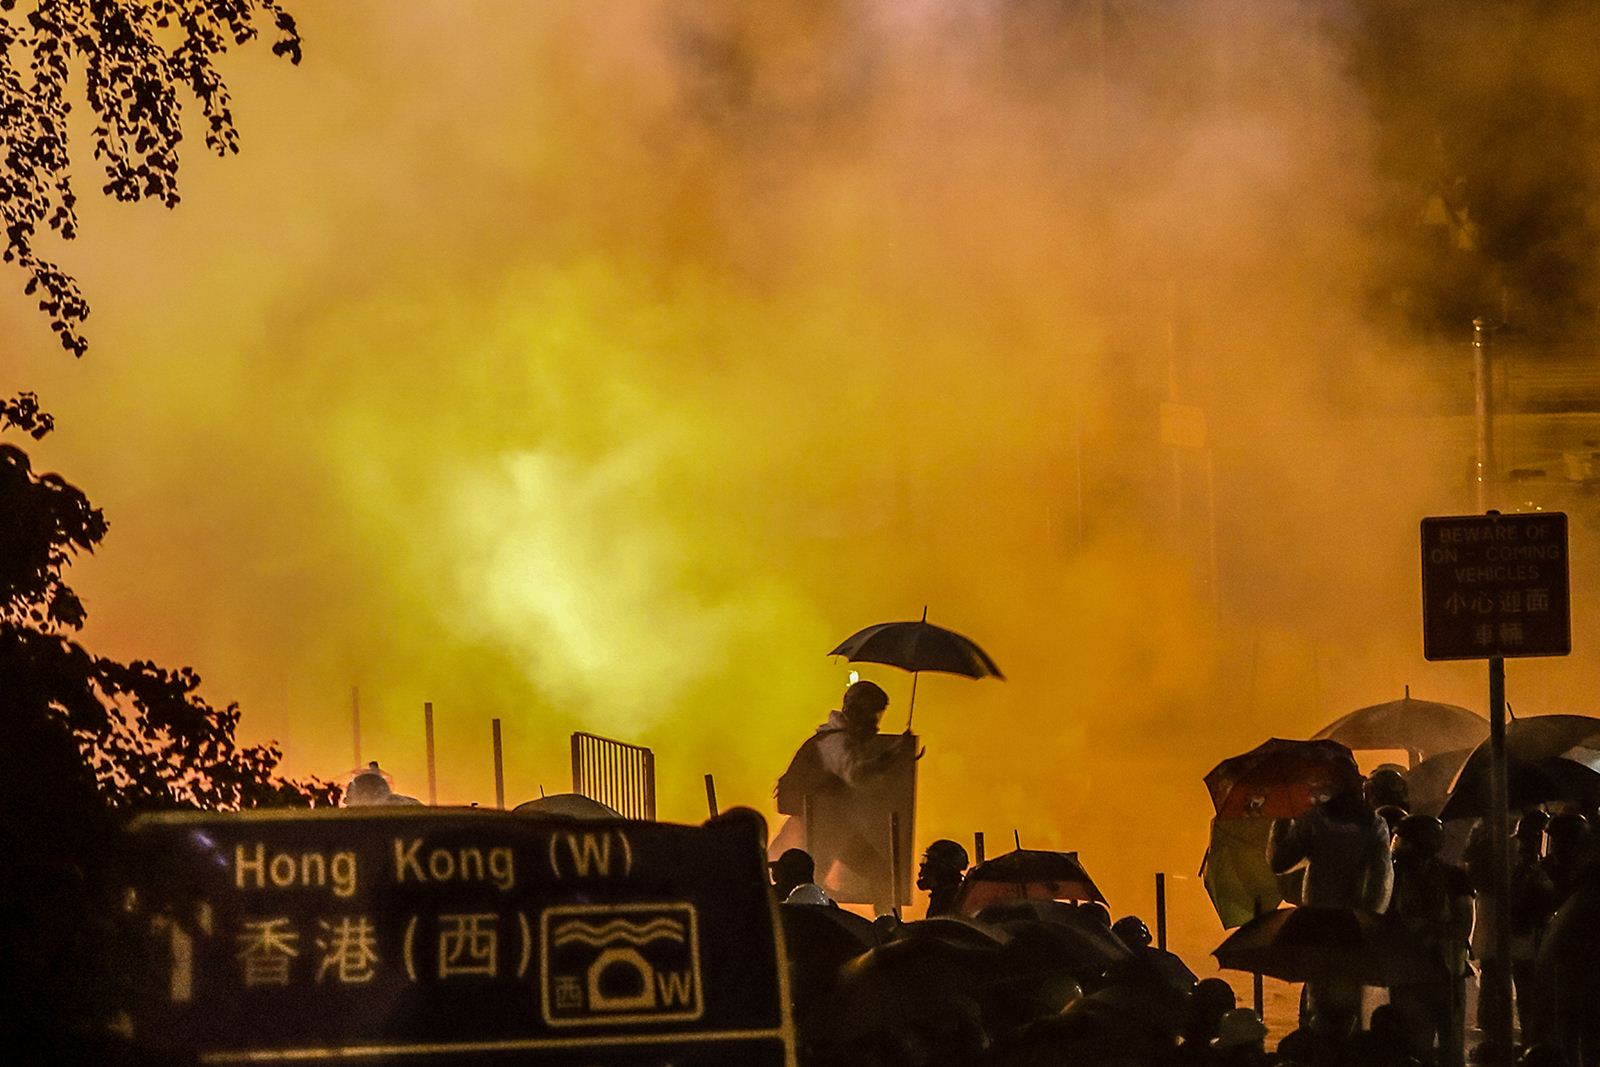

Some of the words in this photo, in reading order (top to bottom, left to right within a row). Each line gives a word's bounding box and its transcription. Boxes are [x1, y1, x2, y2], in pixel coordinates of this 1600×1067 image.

[1440, 525, 1518, 544] BEWARE
[1526, 524, 1551, 540] OF
[1431, 548, 1458, 564] ON
[1486, 545, 1560, 561] COMING
[1455, 565, 1540, 583] VEHICLES
[1446, 588, 1550, 615] 小心迎面
[235, 843, 358, 897] Hong
[395, 836, 516, 891] Kong
[549, 830, 633, 879] (W)
[555, 977, 584, 1010] 西
[656, 970, 693, 1008] W
